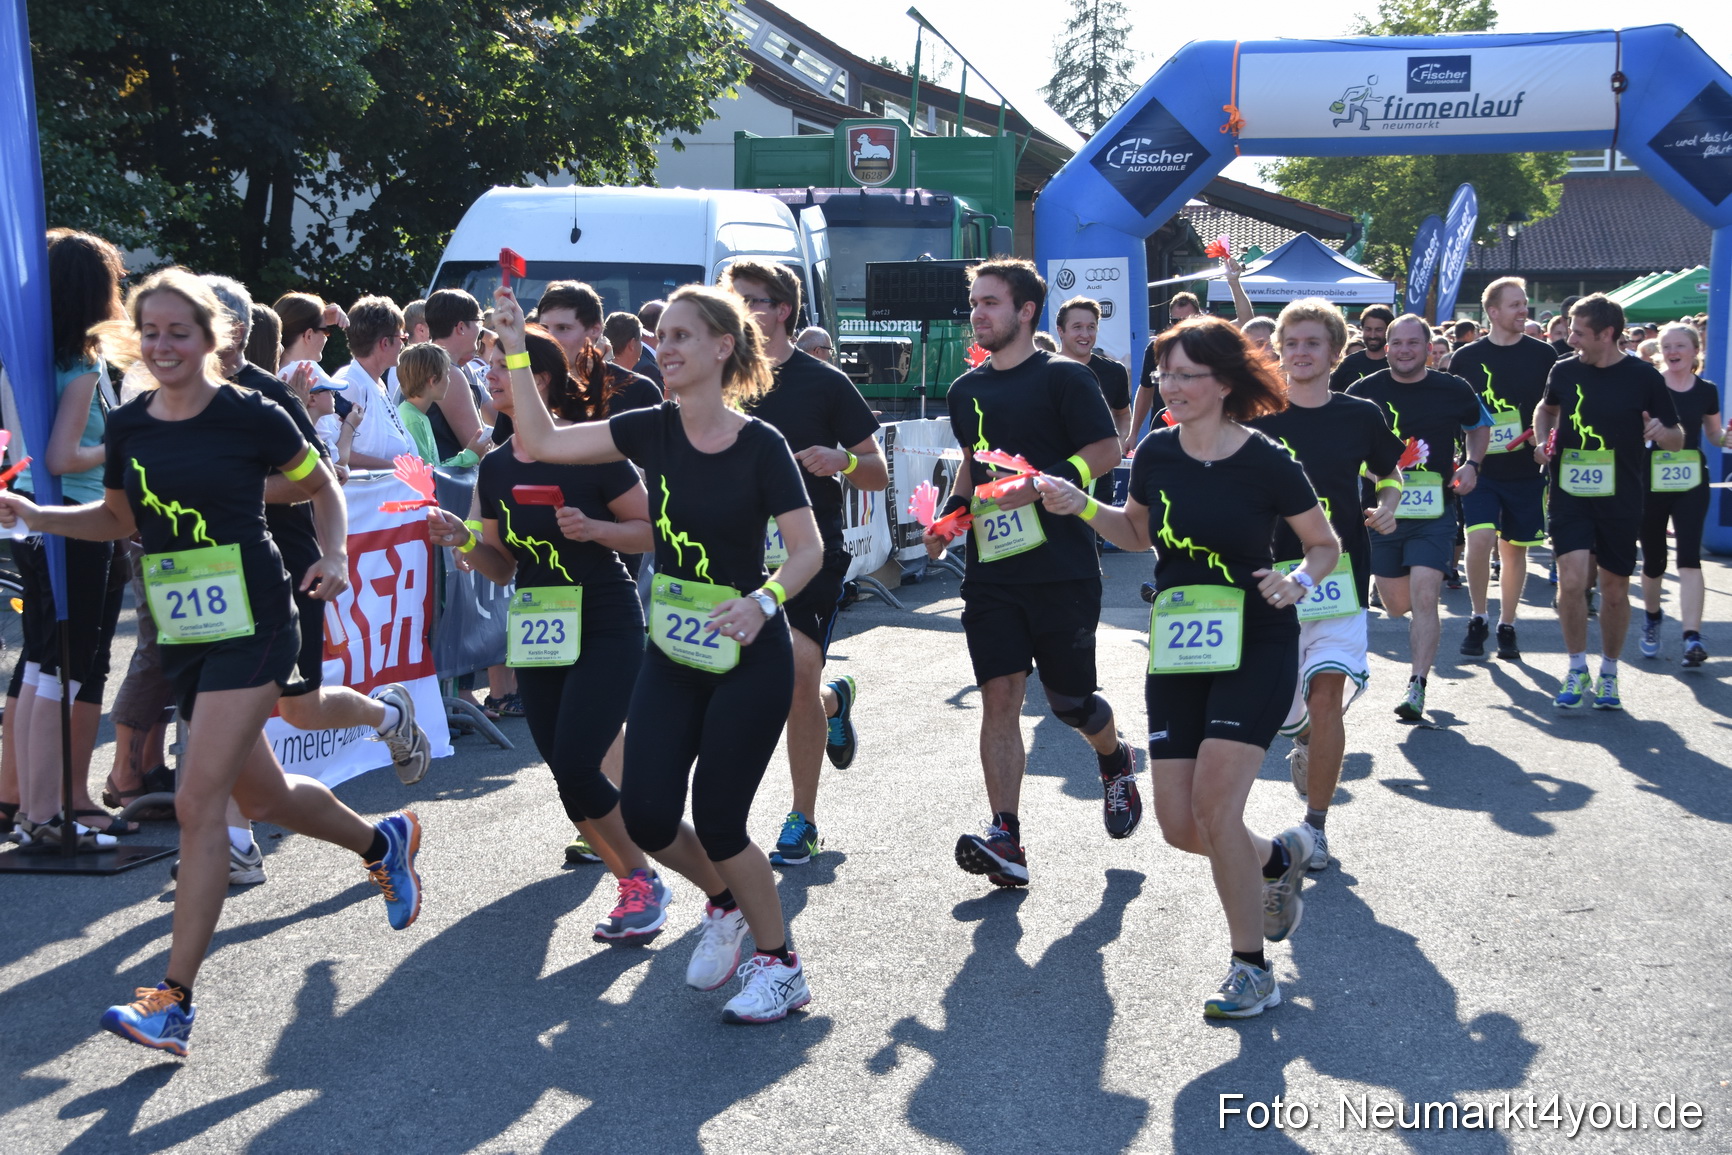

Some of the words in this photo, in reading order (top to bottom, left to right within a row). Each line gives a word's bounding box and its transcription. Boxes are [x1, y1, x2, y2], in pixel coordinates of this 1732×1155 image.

[1420, 67, 1467, 80] Fischer
[1383, 91, 1526, 120] firmenlauf
[1382, 120, 1440, 130] neumarkt
[1675, 135, 1698, 147] und
[1700, 131, 1721, 143] das
[1120, 145, 1193, 164] Fischer
[861, 171, 883, 180] 1628
[1490, 427, 1514, 443] 54
[1569, 468, 1603, 484] 249
[1661, 466, 1692, 480] 230
[1400, 490, 1434, 505] 234
[983, 510, 1023, 542] 251
[1296, 581, 1341, 604] 36
[166, 585, 227, 619] 218
[521, 618, 566, 645] 223
[666, 613, 720, 649] 222
[1168, 620, 1223, 649] 225
